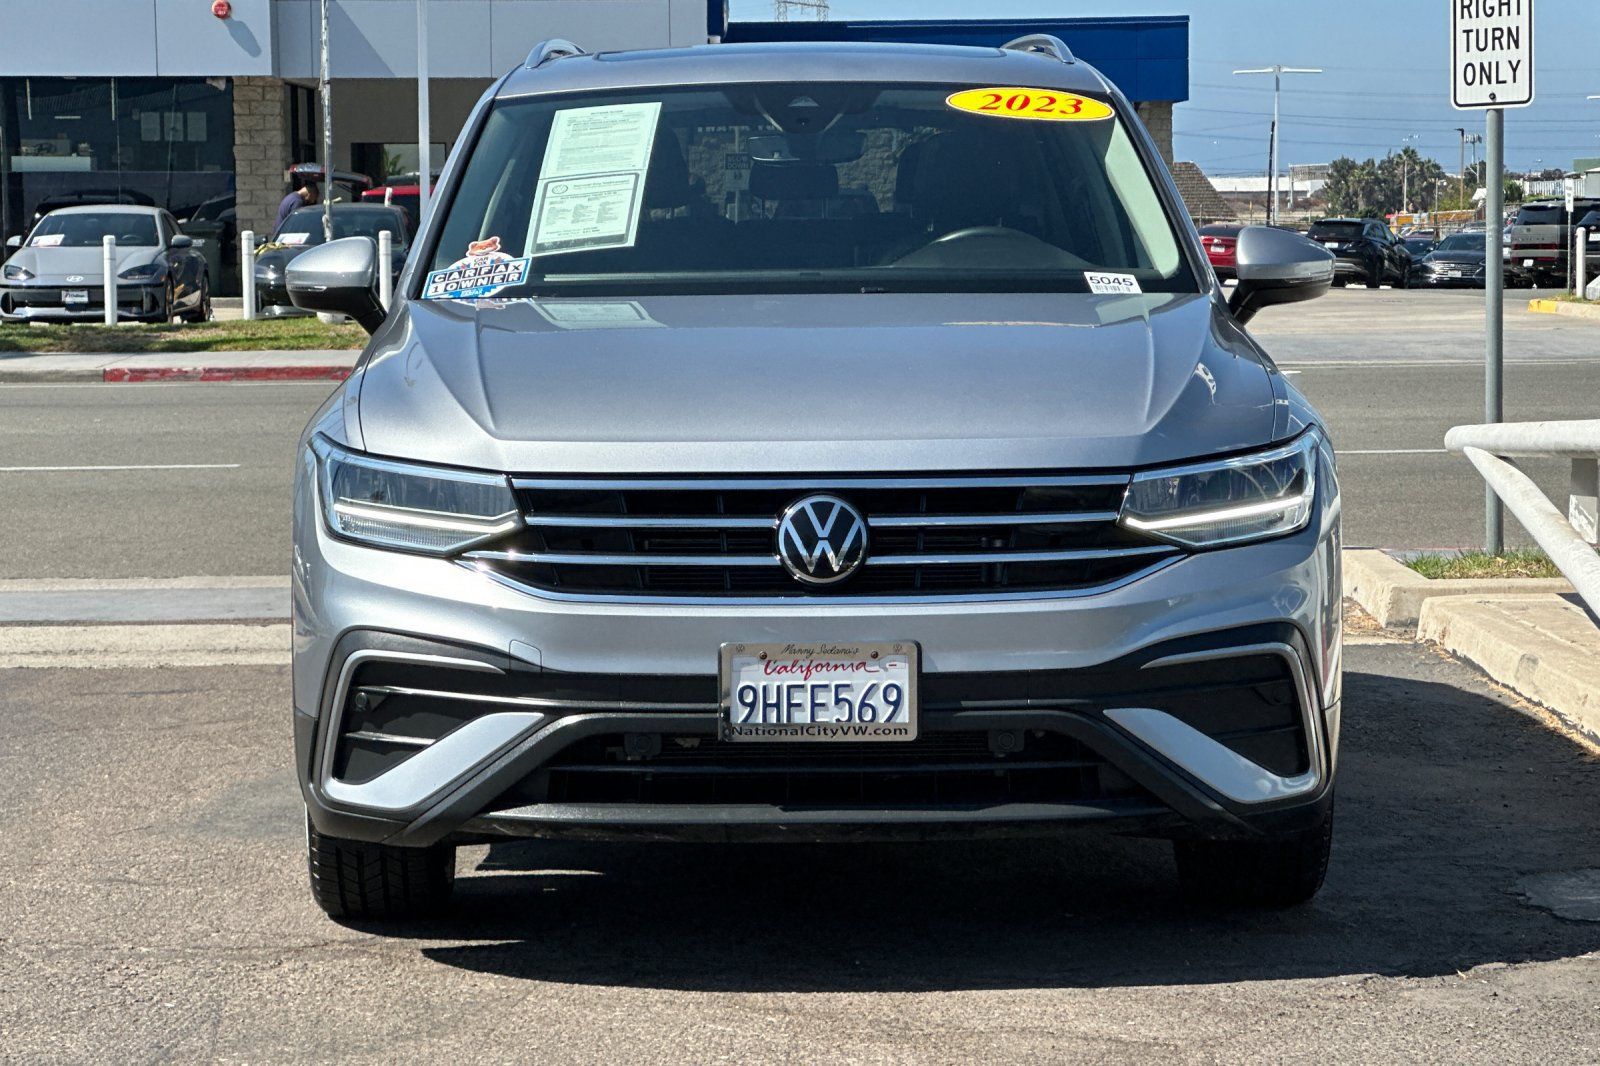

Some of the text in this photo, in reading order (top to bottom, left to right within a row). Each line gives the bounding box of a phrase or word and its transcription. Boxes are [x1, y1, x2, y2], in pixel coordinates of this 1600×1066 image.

[1462, 26, 1520, 52] TURN
[1463, 60, 1521, 86] ONLY
[978, 93, 1083, 115] 2023
[433, 264, 522, 283] CARFAX
[446, 274, 519, 291] OWNER
[1089, 276, 1133, 286] 5045
[764, 659, 880, 681] California
[737, 683, 902, 723] 9HFE569
[731, 725, 908, 738] NationalCityVW.com
